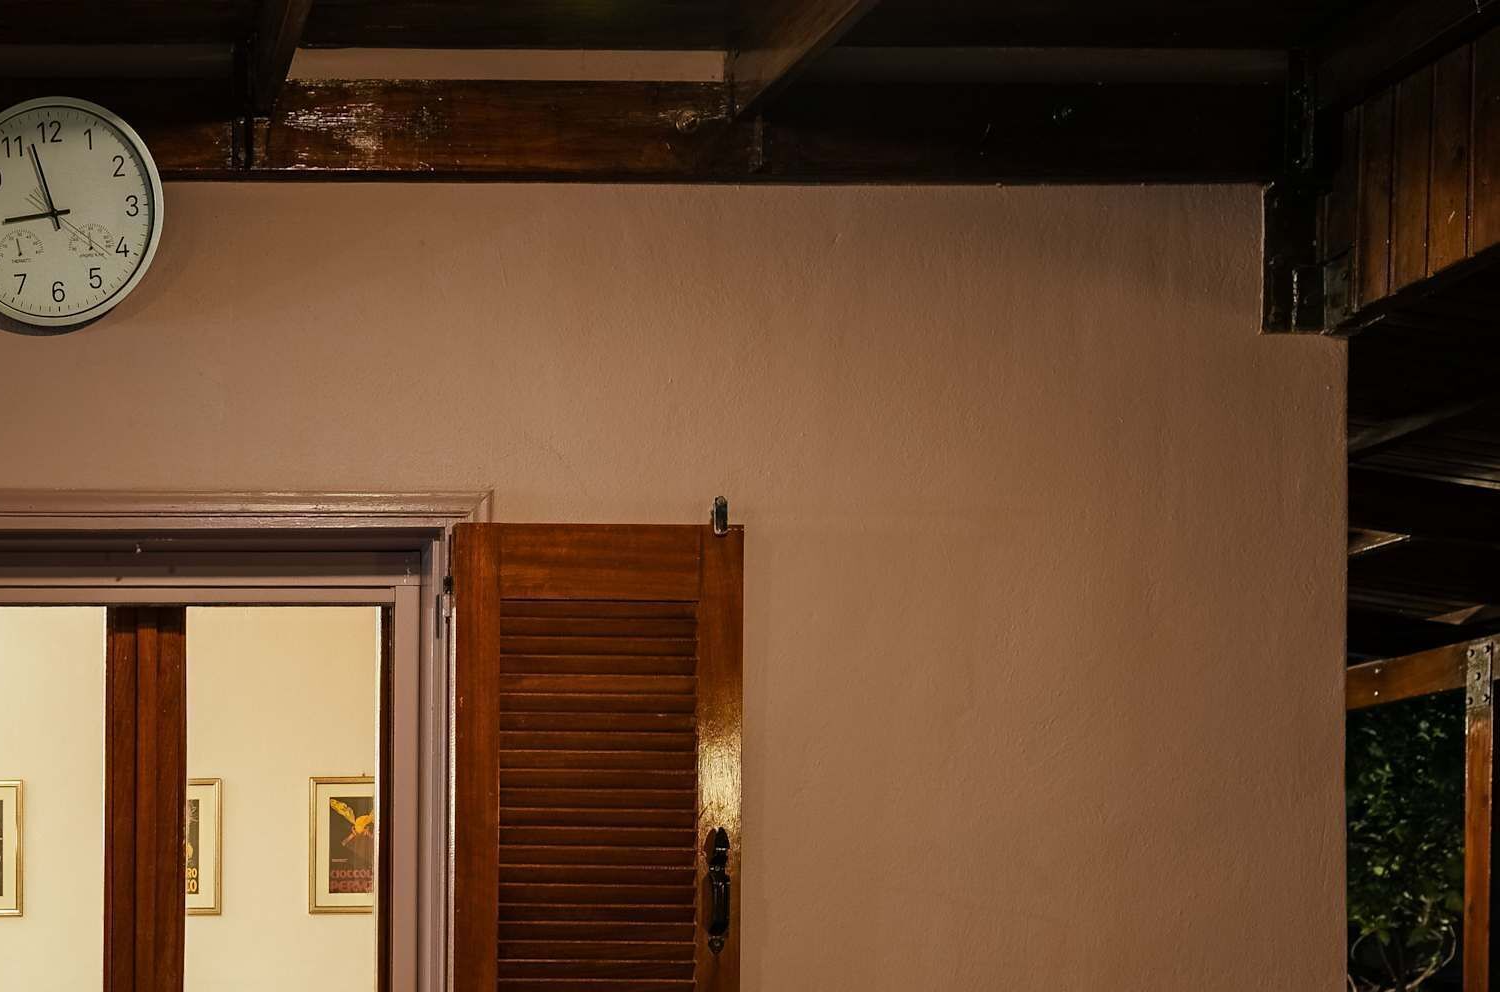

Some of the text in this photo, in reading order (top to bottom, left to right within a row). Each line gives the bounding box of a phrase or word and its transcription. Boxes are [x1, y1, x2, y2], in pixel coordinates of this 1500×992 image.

[36, 120, 63, 144] 12
[83, 128, 93, 151] 1
[1, 135, 23, 159] 11
[112, 155, 126, 178] 2
[125, 194, 139, 217] 3
[115, 236, 130, 258] 4
[13, 273, 27, 296] 7
[88, 267, 103, 290] 5
[51, 280, 66, 303] 6
